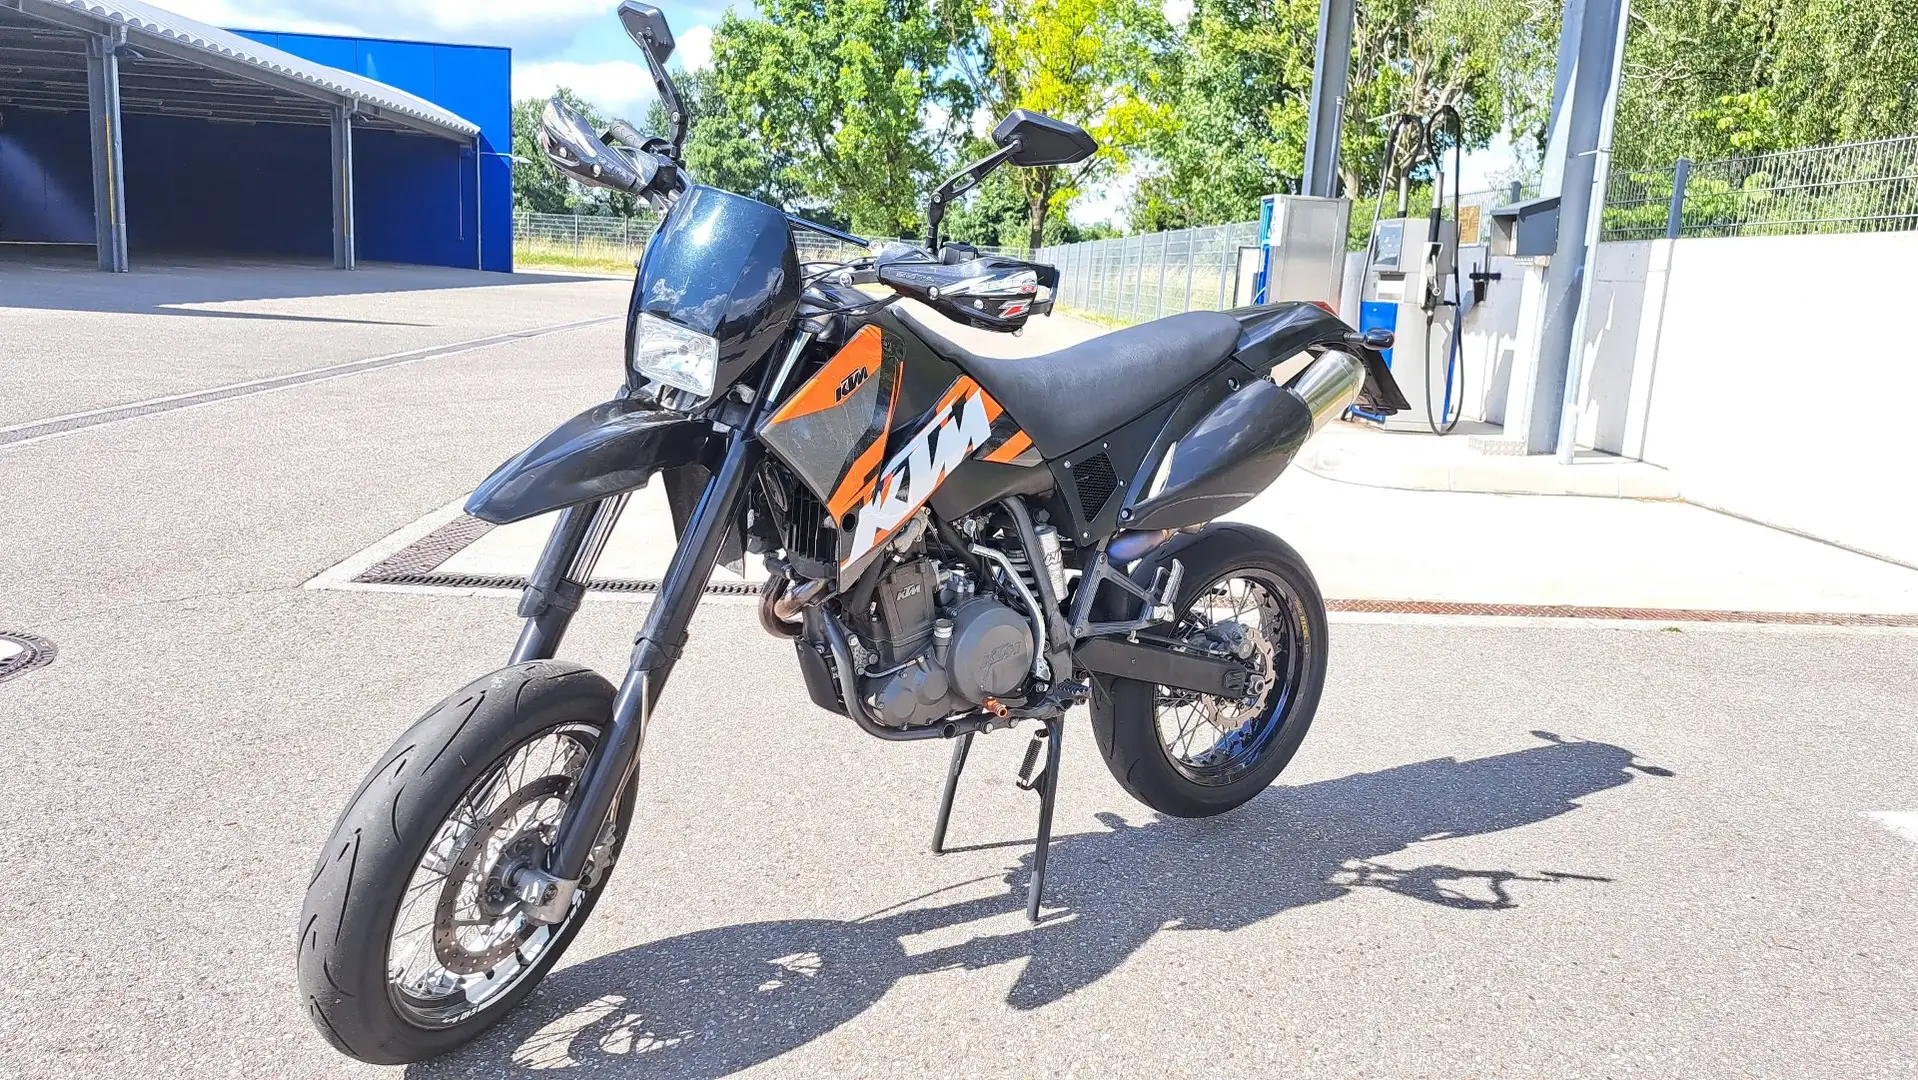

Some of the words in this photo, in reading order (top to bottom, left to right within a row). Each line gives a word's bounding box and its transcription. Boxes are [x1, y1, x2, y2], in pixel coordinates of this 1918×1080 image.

[835, 365, 869, 403] KTM
[850, 387, 992, 562] KTM
[895, 584, 921, 601] KTM
